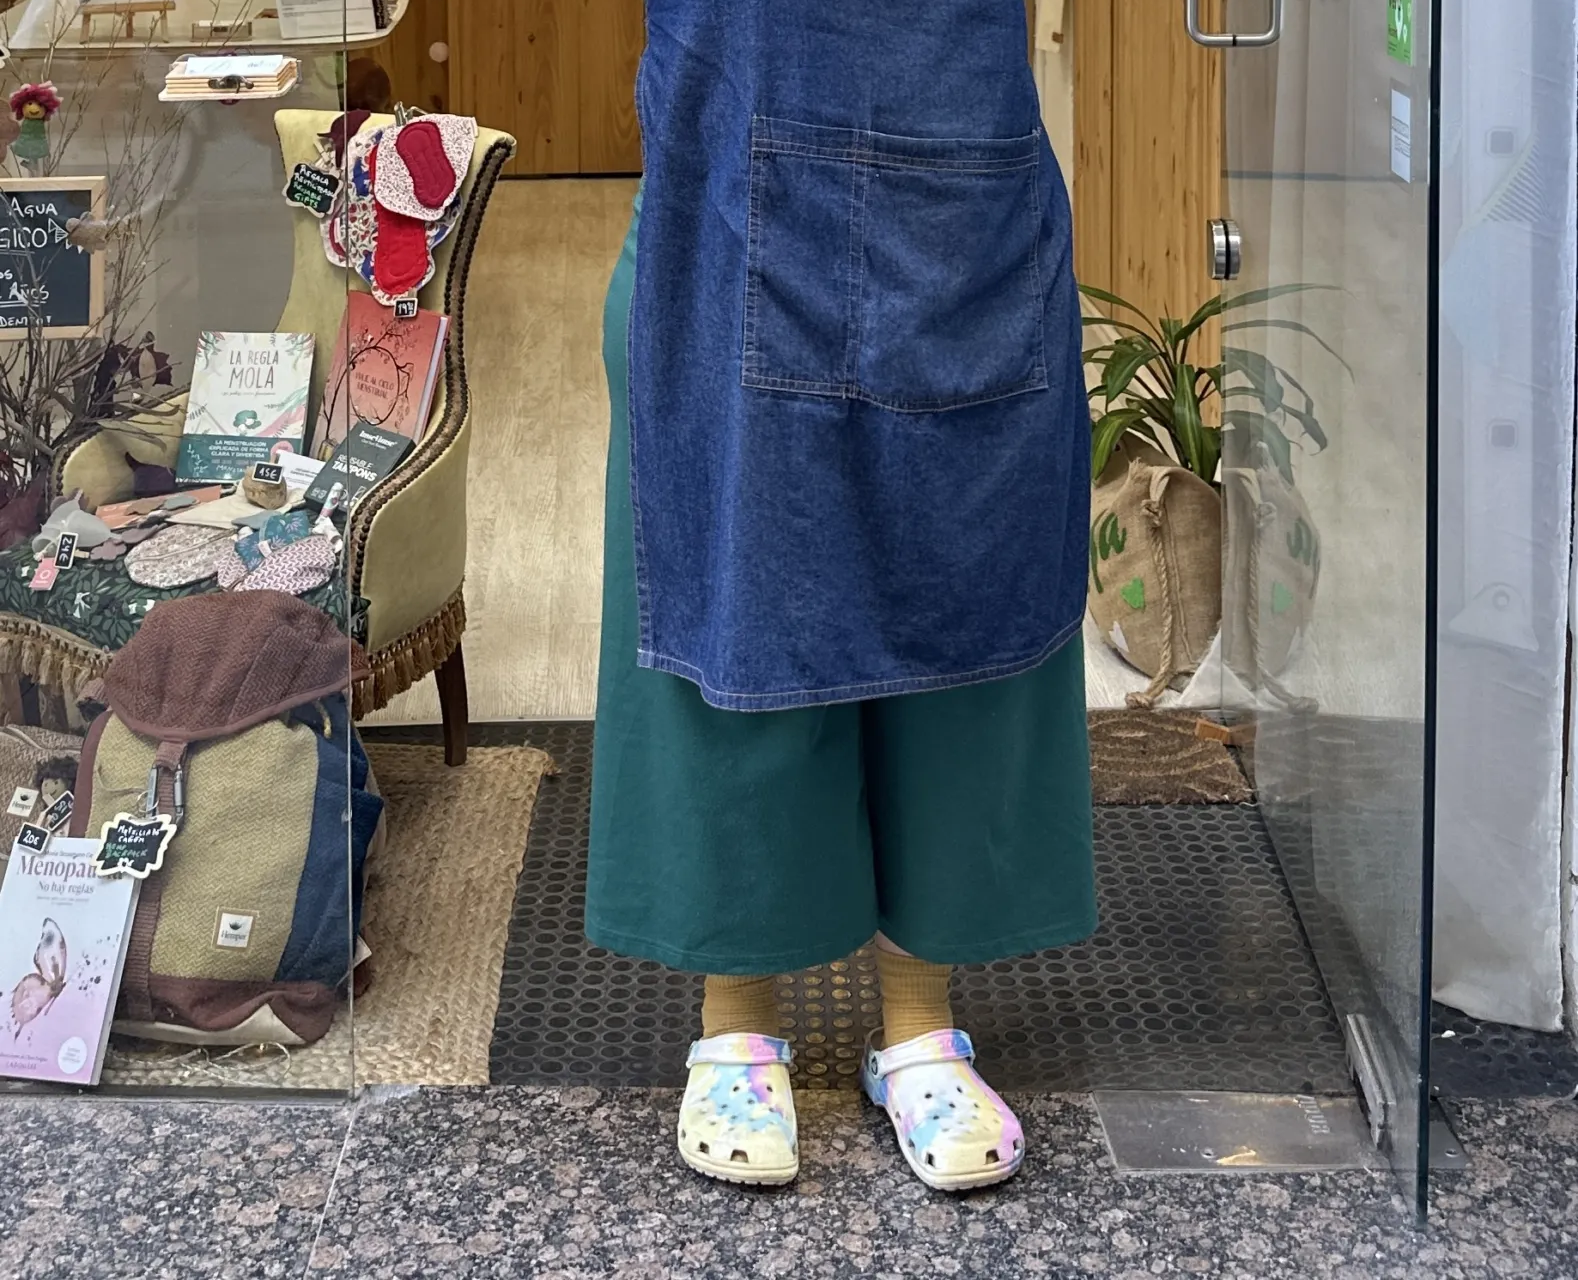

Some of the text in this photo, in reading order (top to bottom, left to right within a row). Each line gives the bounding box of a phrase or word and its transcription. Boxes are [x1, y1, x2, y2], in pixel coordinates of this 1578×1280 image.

[9, 196, 58, 218] AGUA
[229, 350, 279, 365] LA REGLA
[228, 365, 274, 389] MOLA
[332, 460, 378, 481] TAMPONS
[39, 881, 94, 896] No hay reglas
